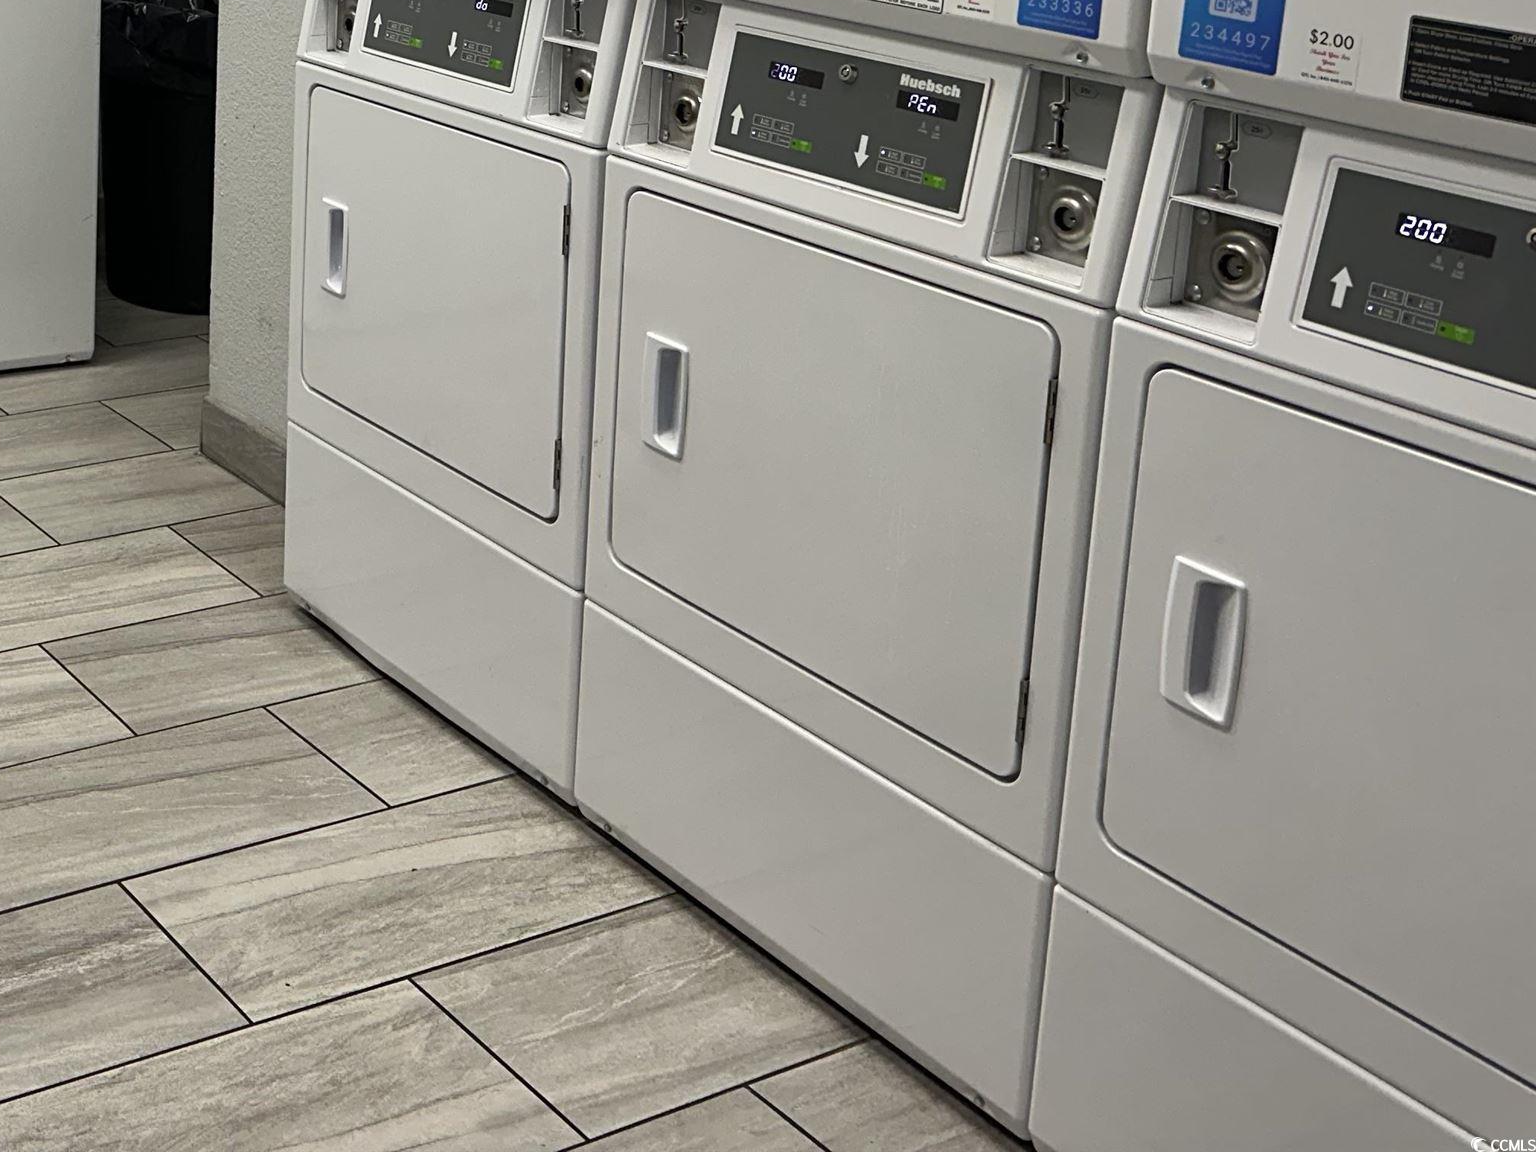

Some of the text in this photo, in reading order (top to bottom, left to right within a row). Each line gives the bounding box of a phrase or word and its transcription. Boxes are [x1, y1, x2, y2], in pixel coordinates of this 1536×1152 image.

[1190, 22, 1271, 51] 234497
[1309, 28, 1355, 50] $2.00
[770, 63, 798, 82] 200
[899, 73, 961, 98] Huebsch
[1399, 215, 1447, 244] 200
